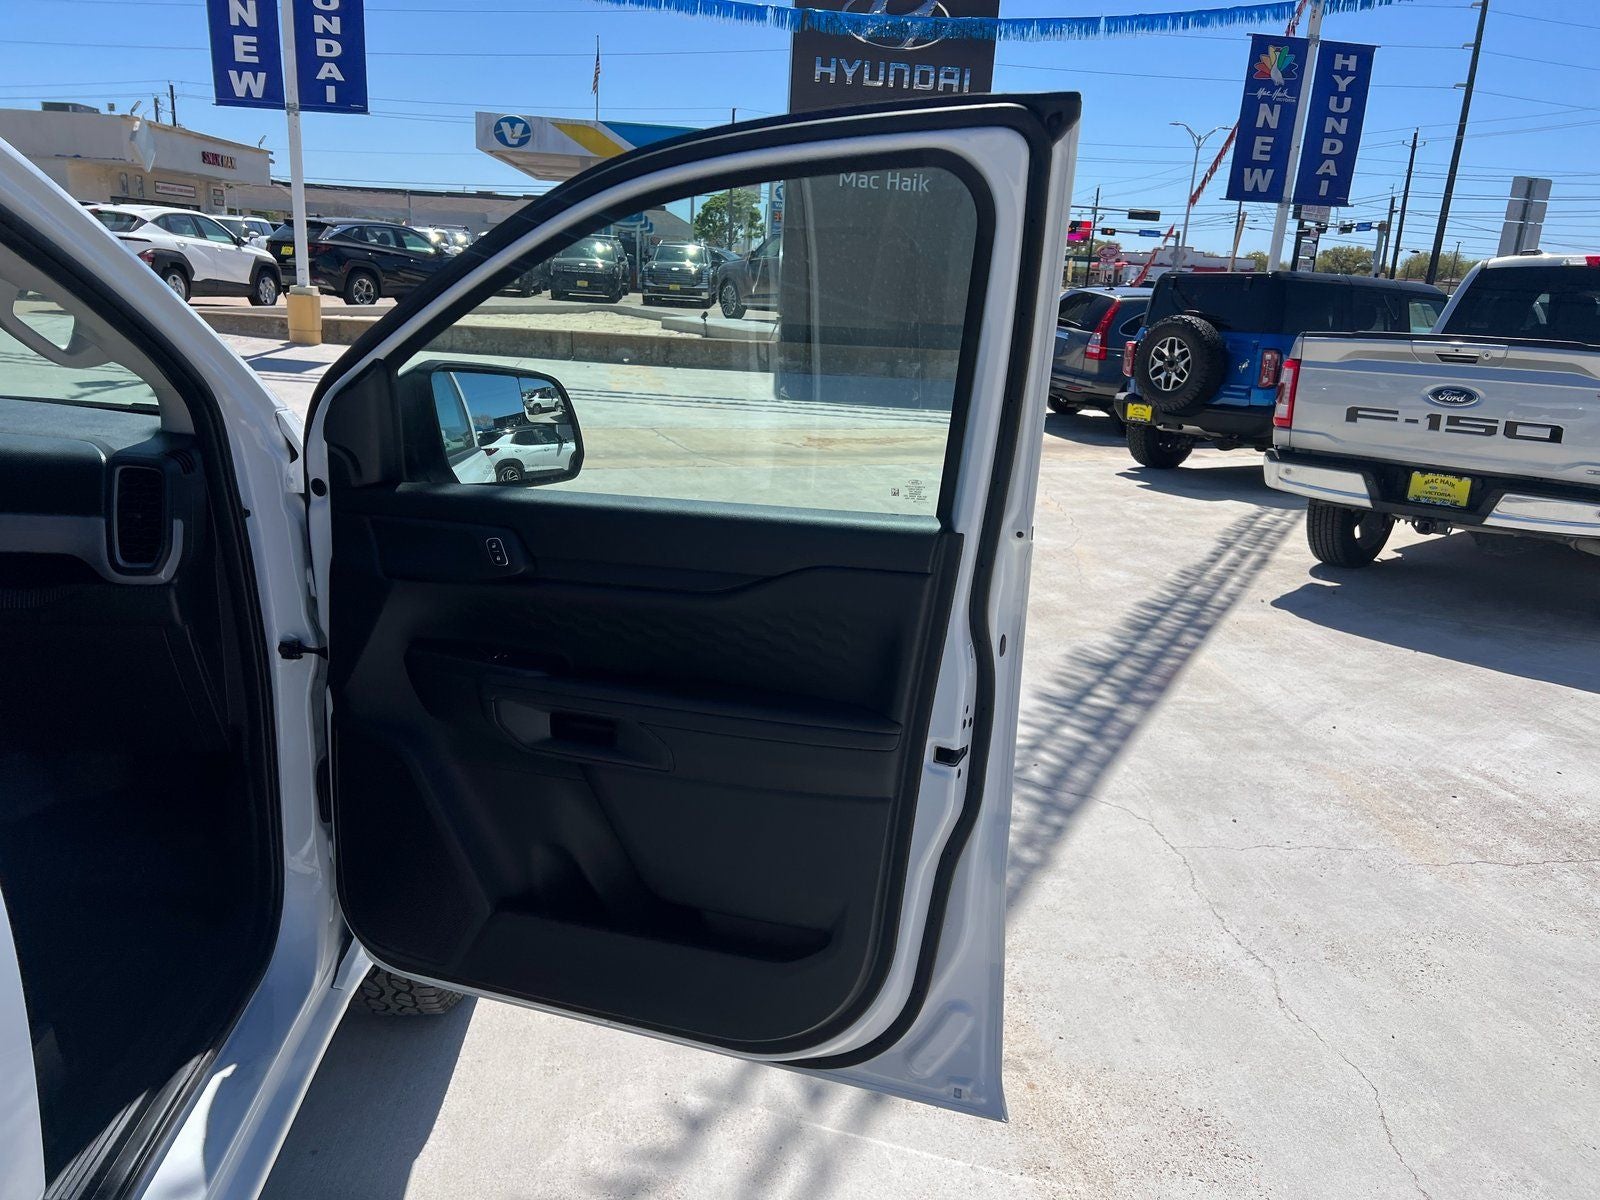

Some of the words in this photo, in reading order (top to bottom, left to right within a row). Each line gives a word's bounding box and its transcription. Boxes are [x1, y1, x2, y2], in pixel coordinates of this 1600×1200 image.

[228, 0, 266, 98] NEW
[814, 56, 971, 93] HYUNDAI
[1315, 53, 1357, 196] HYUNDAI
[1243, 103, 1281, 193] NEW
[839, 173, 879, 189] Mac
[887, 172, 930, 192] Haik
[1438, 390, 1467, 402] Ford
[1345, 406, 1564, 444] F-150
[1424, 478, 1439, 486] MAC
